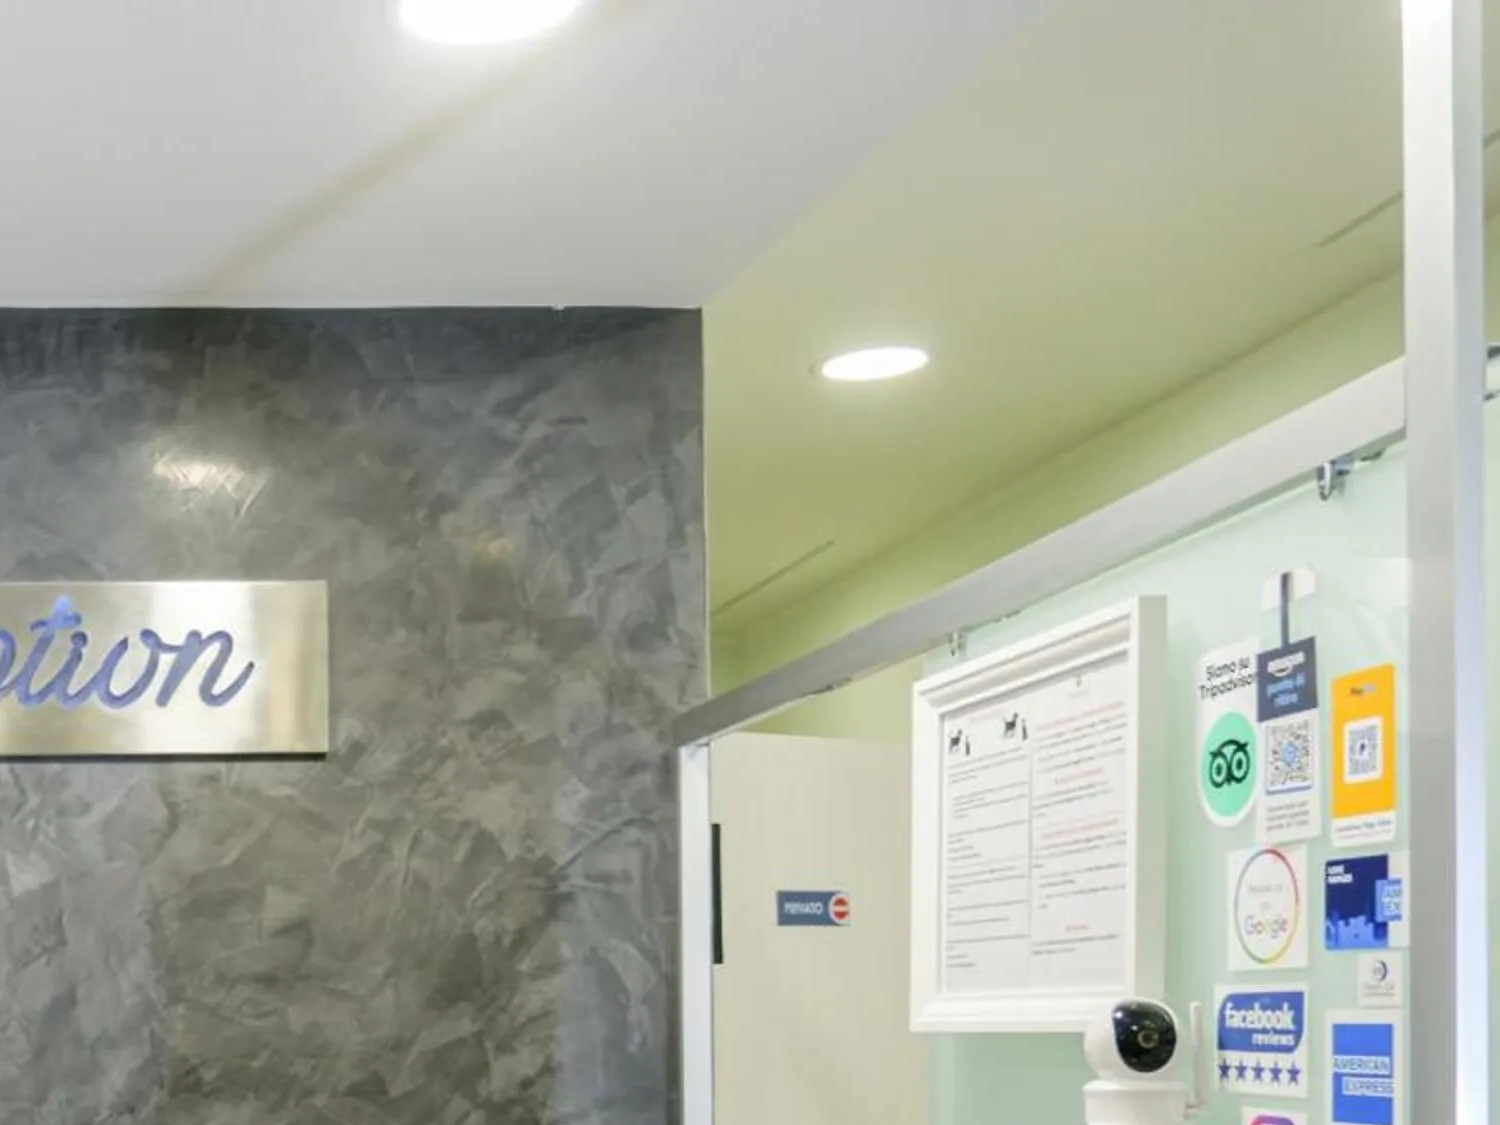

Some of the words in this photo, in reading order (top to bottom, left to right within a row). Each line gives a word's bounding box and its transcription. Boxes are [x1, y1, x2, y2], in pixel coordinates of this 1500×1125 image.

[1205, 660, 1237, 681] Siamo
[1238, 656, 1251, 670] su
[1199, 673, 1257, 700] Tripadvisor
[1244, 914, 1289, 938] Google
[1224, 1001, 1296, 1030] facebook
[1251, 1032, 1295, 1046] reviews
[1334, 1055, 1391, 1074] AMERICAN
